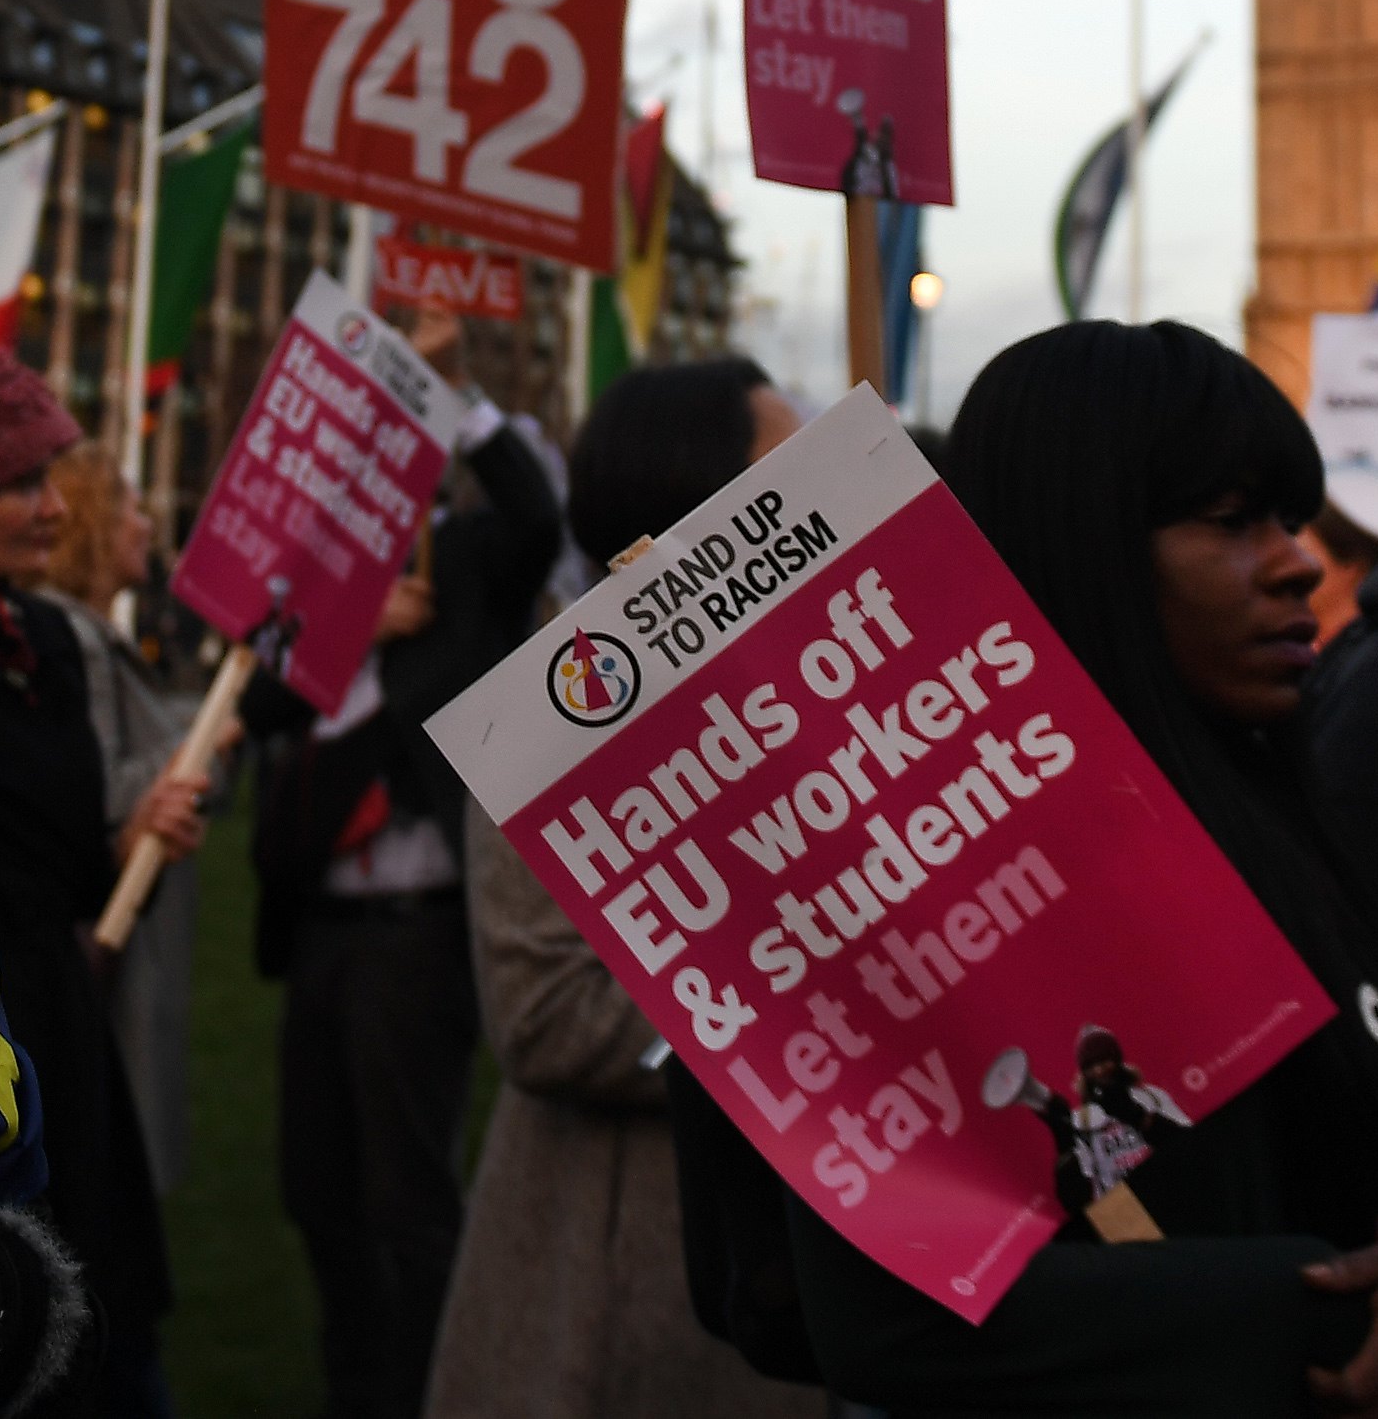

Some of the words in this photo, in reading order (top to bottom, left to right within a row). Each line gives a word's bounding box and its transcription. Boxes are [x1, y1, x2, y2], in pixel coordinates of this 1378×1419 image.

[753, 38, 836, 108] stay
[263, 374, 317, 434] EU
[623, 533, 736, 634] STAND
[731, 490, 783, 546] UP
[647, 616, 706, 669] TO
[699, 510, 838, 633] RACISM
[540, 677, 801, 898] Hands
[798, 566, 914, 700] off
[601, 838, 732, 977] EU
[728, 618, 1038, 877] workers
[671, 964, 759, 1052] &
[748, 711, 1077, 996] students
[726, 1006, 876, 1135] Let
[863, 843, 1069, 1022] them
[811, 1045, 969, 1210] stay
